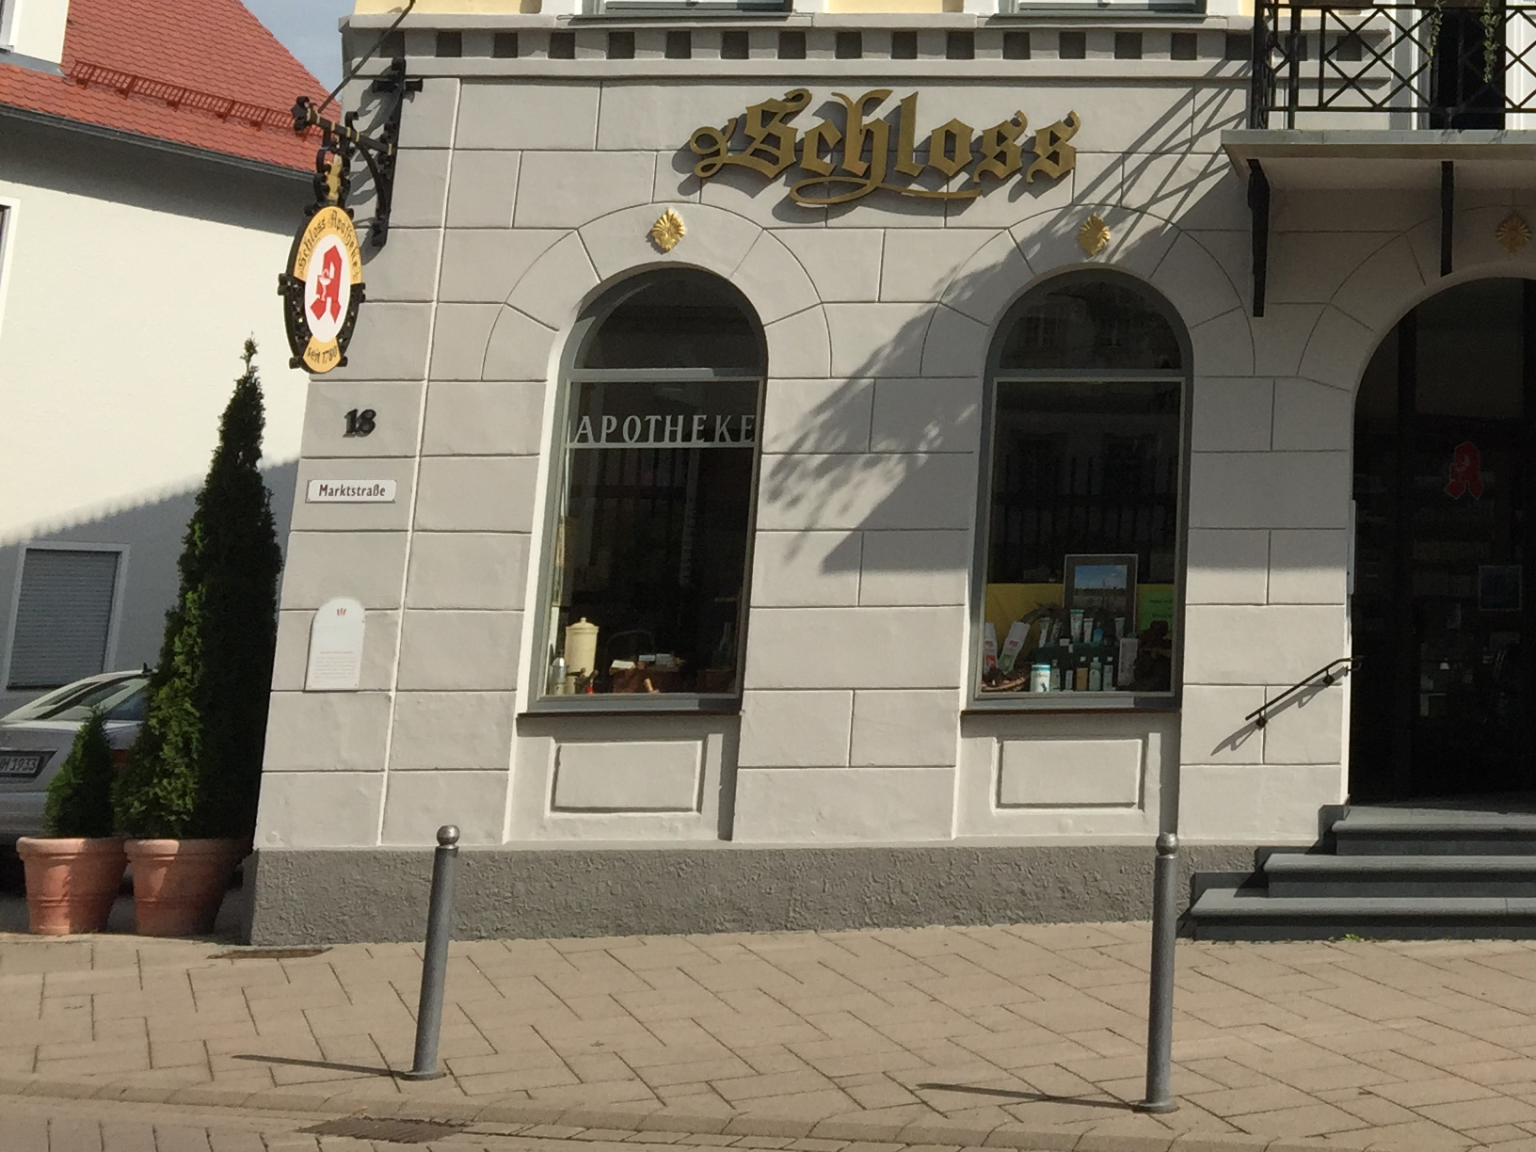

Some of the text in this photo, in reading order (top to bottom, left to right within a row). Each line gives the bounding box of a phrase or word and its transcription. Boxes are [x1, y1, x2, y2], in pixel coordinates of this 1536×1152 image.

[690, 88, 1081, 204] Schloss
[297, 209, 361, 281] Schloss Apotheke
[342, 408, 377, 438] 18
[572, 414, 756, 445] APOTHEKE
[319, 484, 386, 497] Marktstraße
